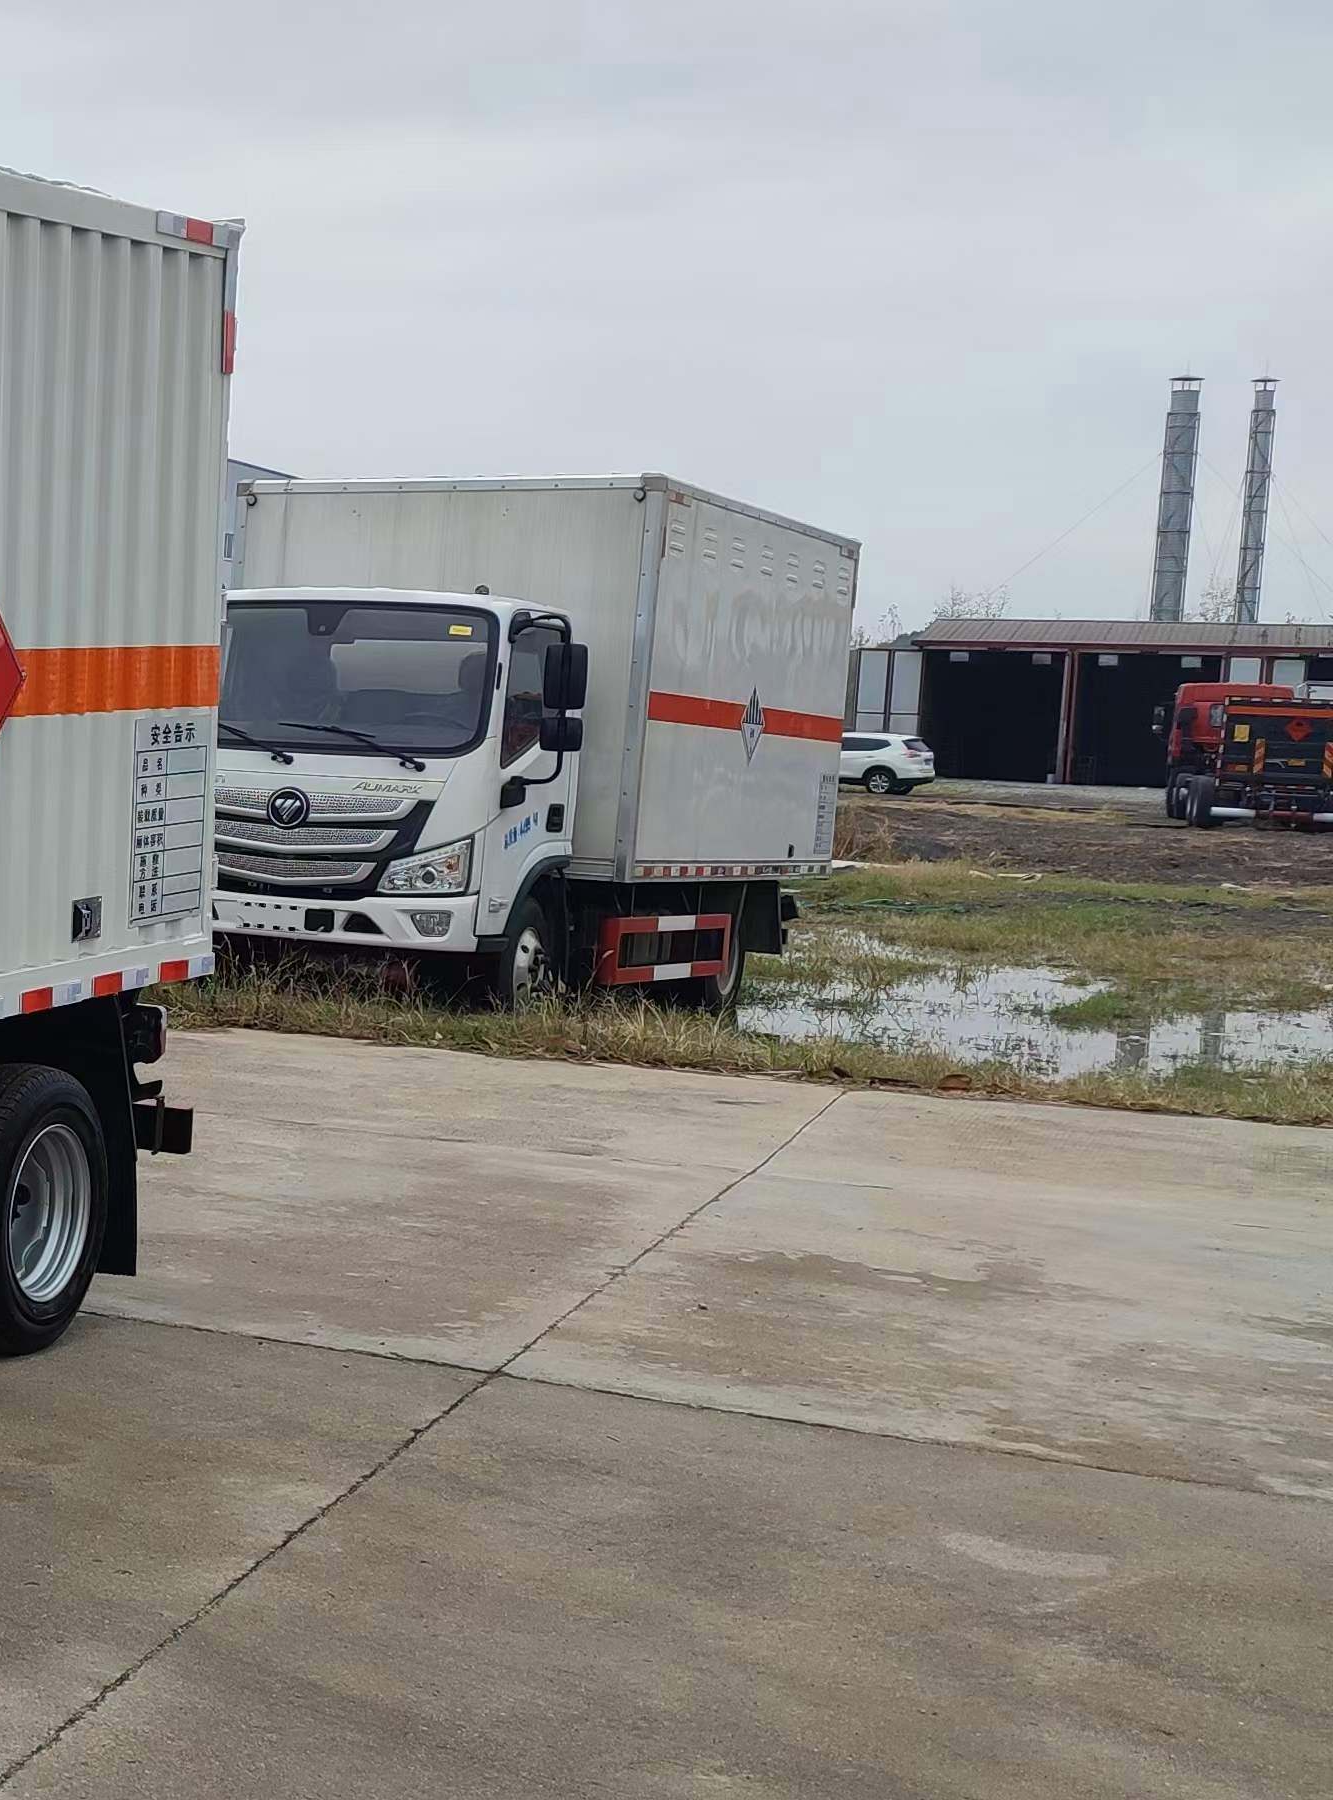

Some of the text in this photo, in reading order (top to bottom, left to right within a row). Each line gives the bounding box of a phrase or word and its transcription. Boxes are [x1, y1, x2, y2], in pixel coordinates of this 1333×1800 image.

[150, 722, 196, 746] 安全告示
[353, 781, 423, 795] AUMARK
